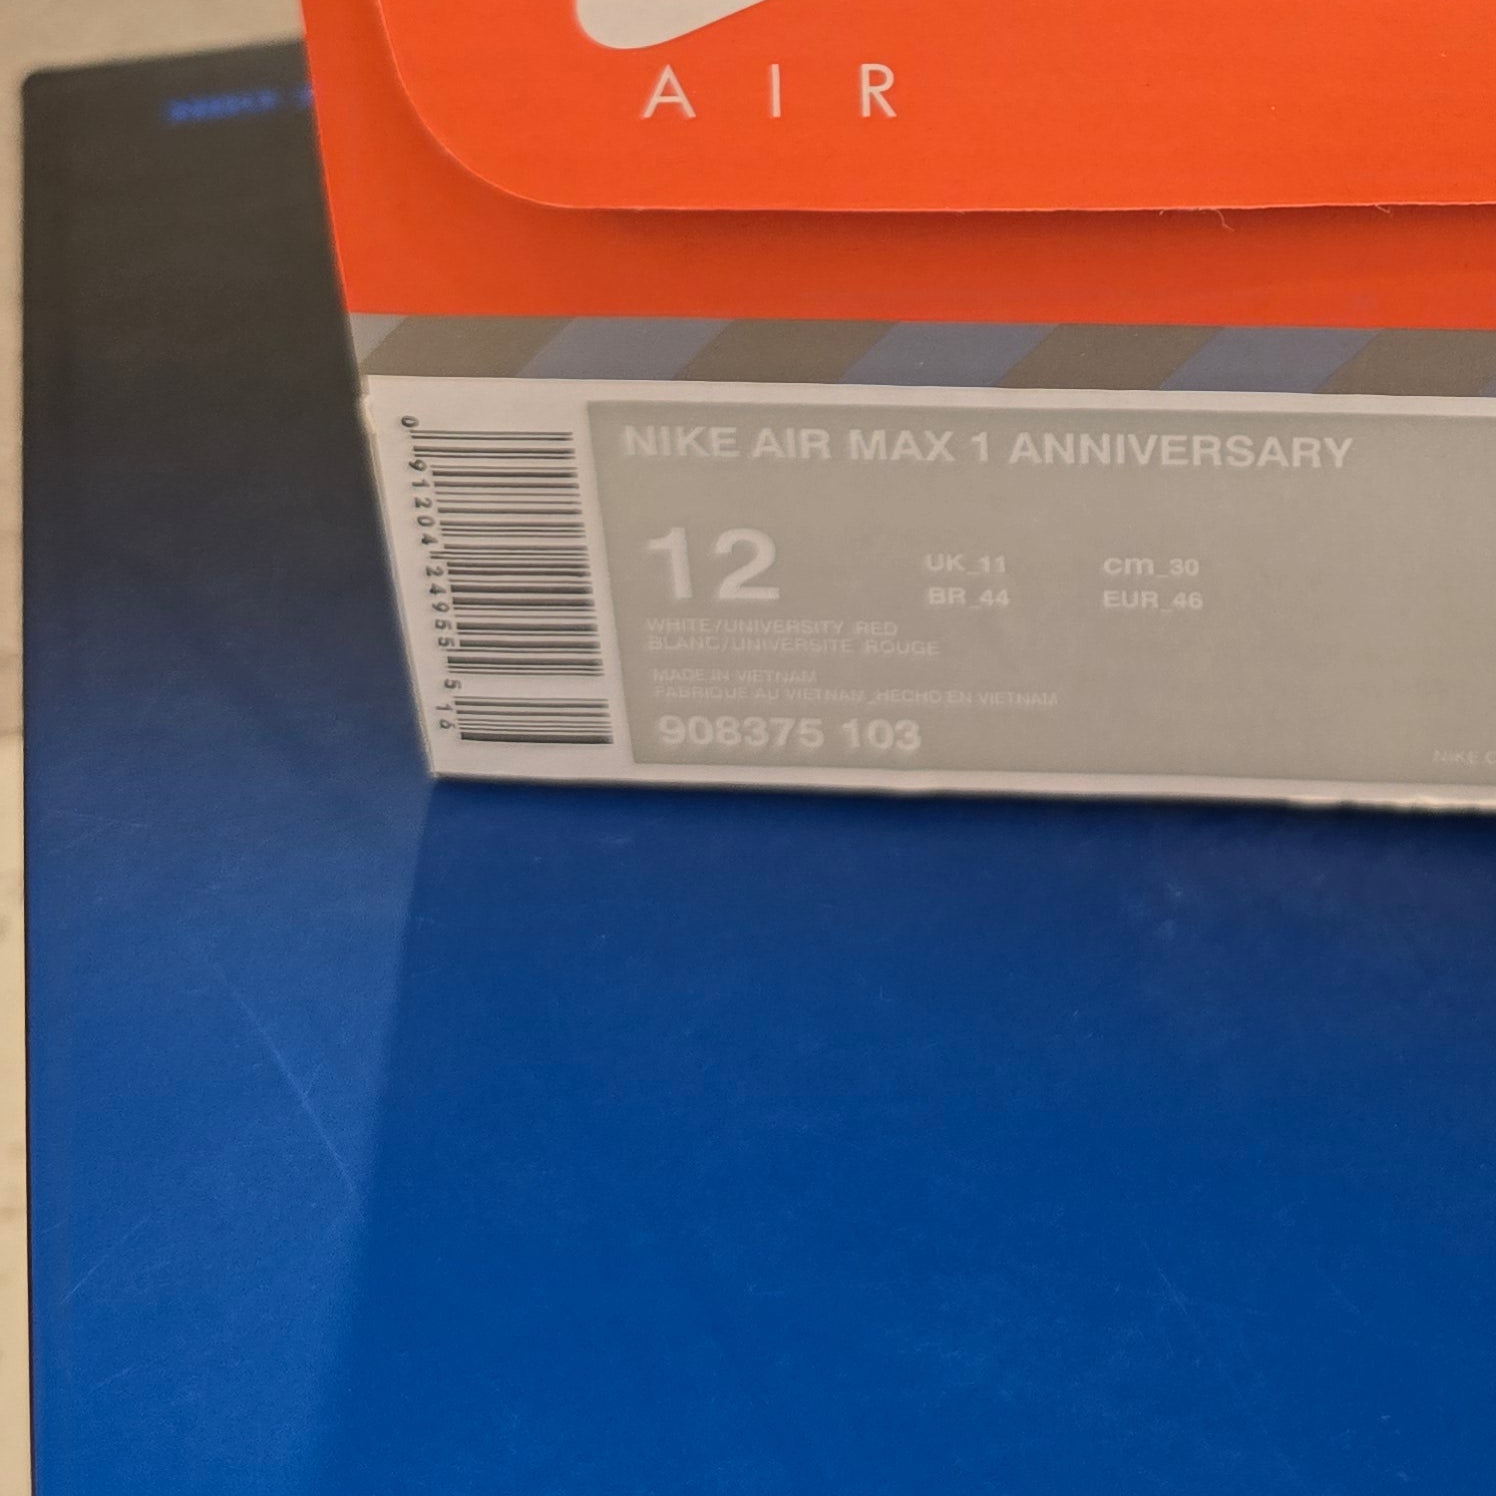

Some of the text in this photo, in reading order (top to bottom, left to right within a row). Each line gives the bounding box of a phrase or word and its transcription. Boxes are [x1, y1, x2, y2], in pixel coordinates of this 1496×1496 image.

[642, 63, 897, 118] AIR
[401, 415, 419, 428] 0
[623, 425, 1353, 468] NIKE AIR MAX 1 ANNIVERSARY
[648, 526, 781, 600] 12
[646, 617, 898, 636] WHITE/UNIVERSITY RED
[864, 639, 940, 655] ROUGE
[653, 668, 817, 684] MADE IN VIETNAM
[947, 690, 972, 703] EN
[978, 691, 1058, 706] VIETNAM
[658, 715, 921, 750] 908375 103
